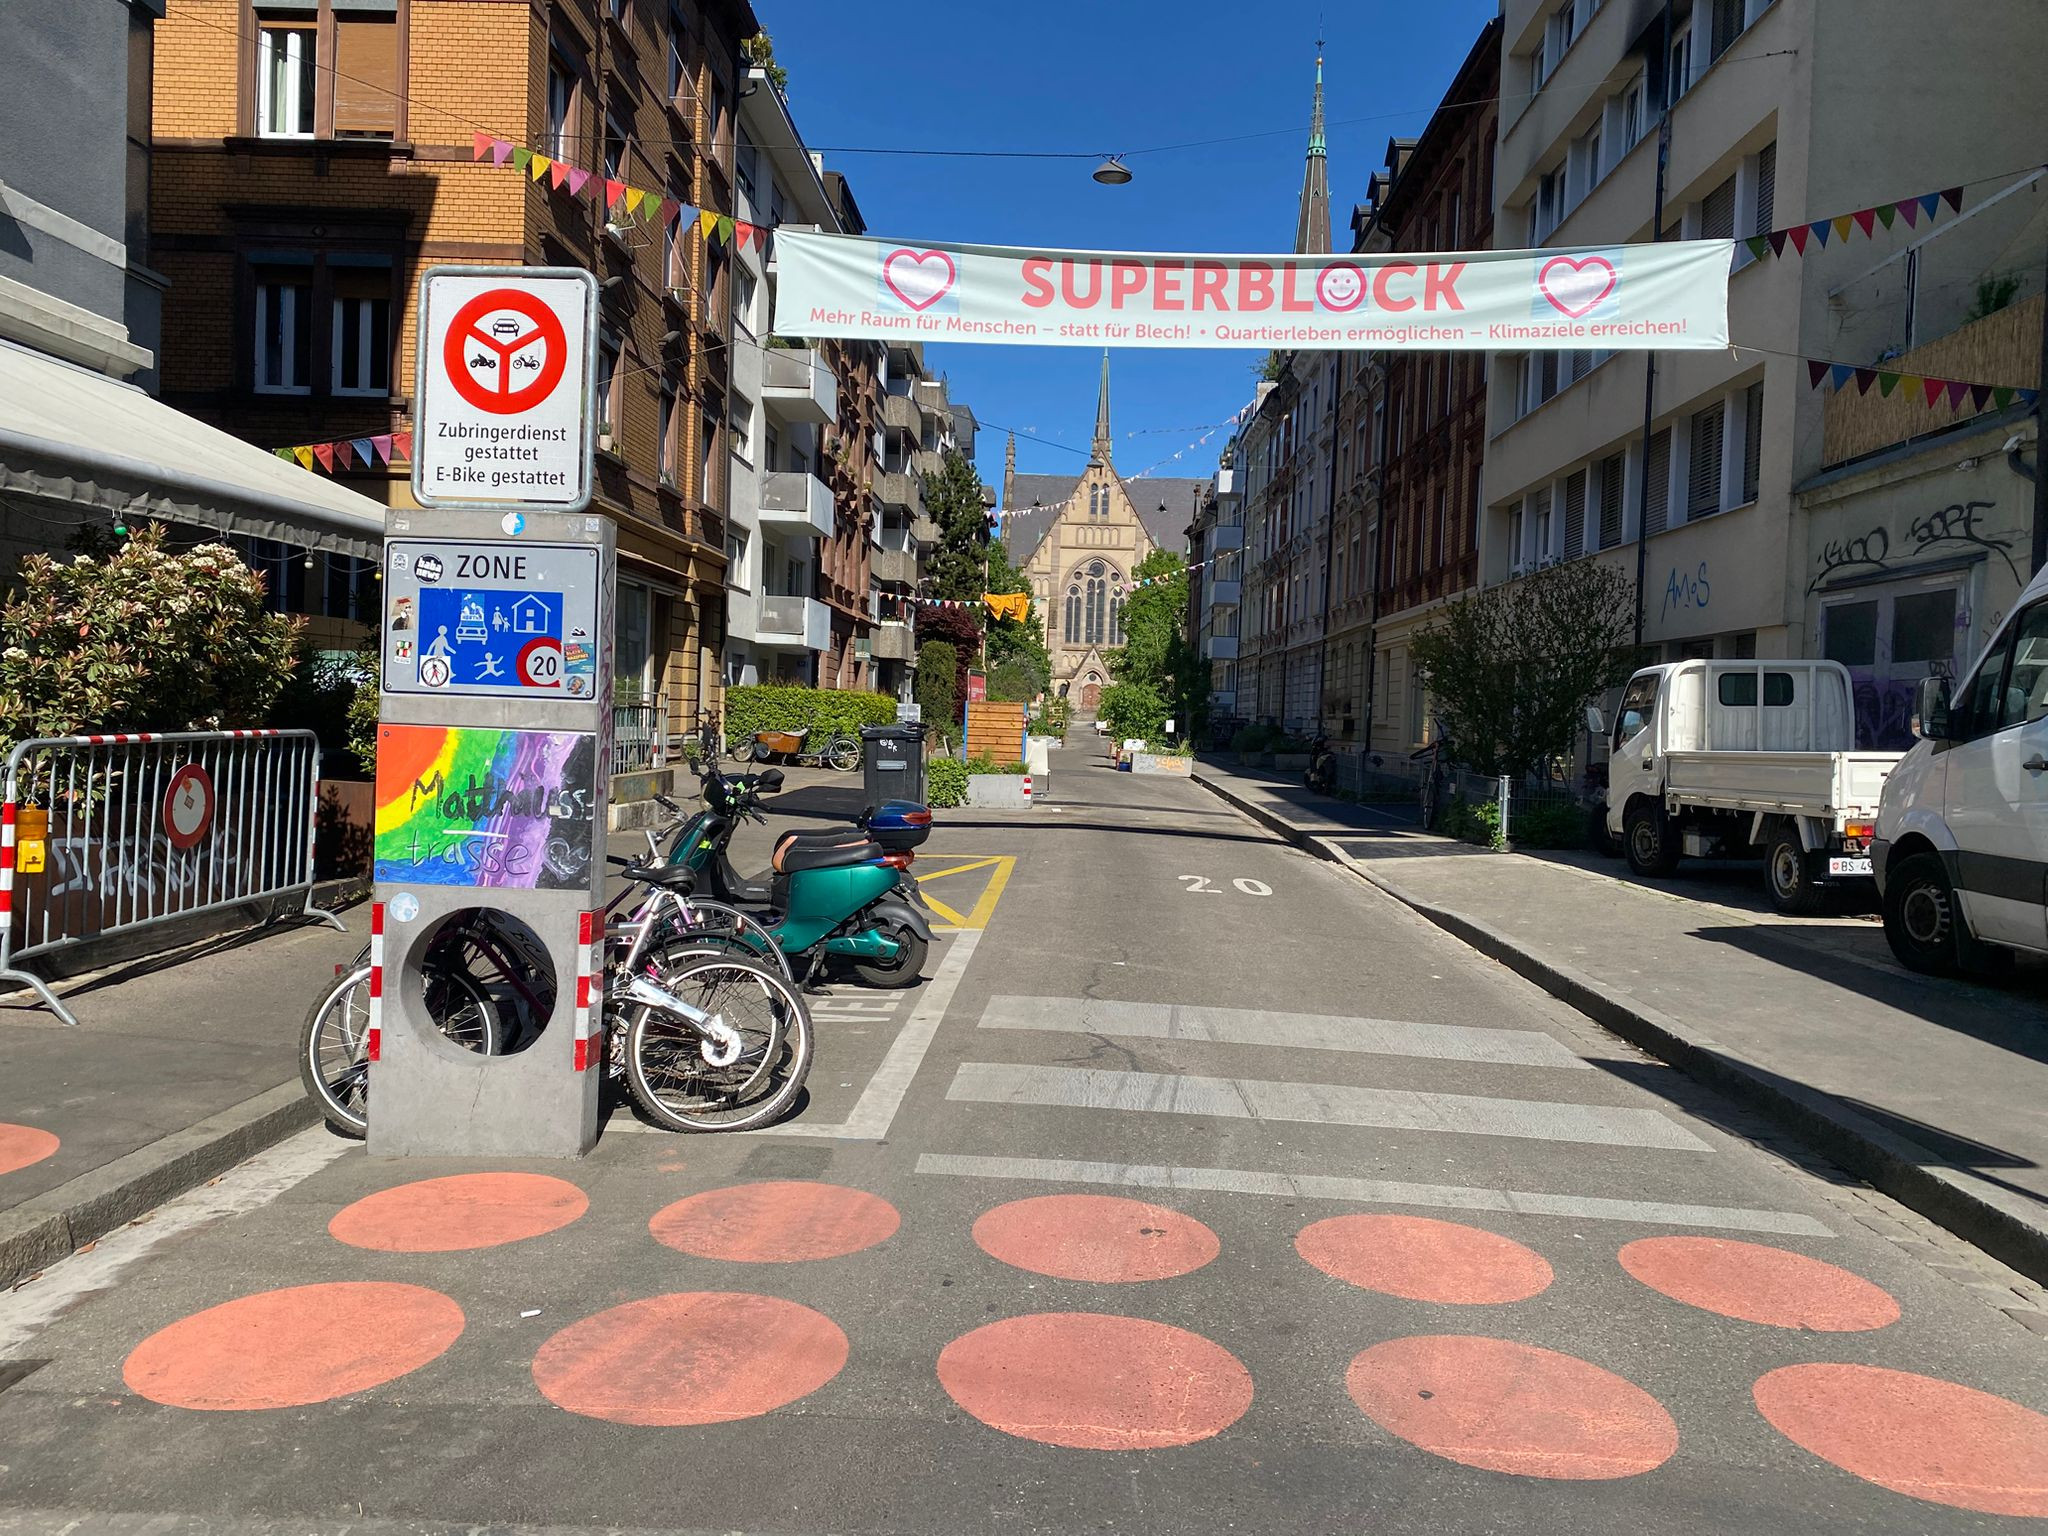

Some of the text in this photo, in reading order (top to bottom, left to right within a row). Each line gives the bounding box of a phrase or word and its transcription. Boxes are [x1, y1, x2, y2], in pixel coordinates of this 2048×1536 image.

[1021, 255, 1468, 313] SUPERBLOCK
[810, 307, 856, 325] Mehr
[861, 311, 911, 329] Raum
[916, 314, 942, 331] für
[946, 316, 1037, 336] Menschen
[1059, 322, 1099, 338] statt
[1104, 322, 1131, 338] für
[1135, 323, 1191, 339] Blech!
[1215, 324, 1342, 341] Quartierleben
[1347, 324, 1464, 344] ermöglichen
[1489, 321, 1585, 339] Klimaziele
[1590, 318, 1688, 337] erreichen!
[438, 422, 567, 443] Zubringerdienst
[464, 446, 539, 463] gestattet
[436, 466, 566, 487] E-Bike gestattet
[416, 568, 441, 581] news
[456, 554, 527, 580] ZONE
[533, 656, 557, 676] 20
[1841, 860, 1855, 872] BS
[1177, 874, 1273, 897] 20
